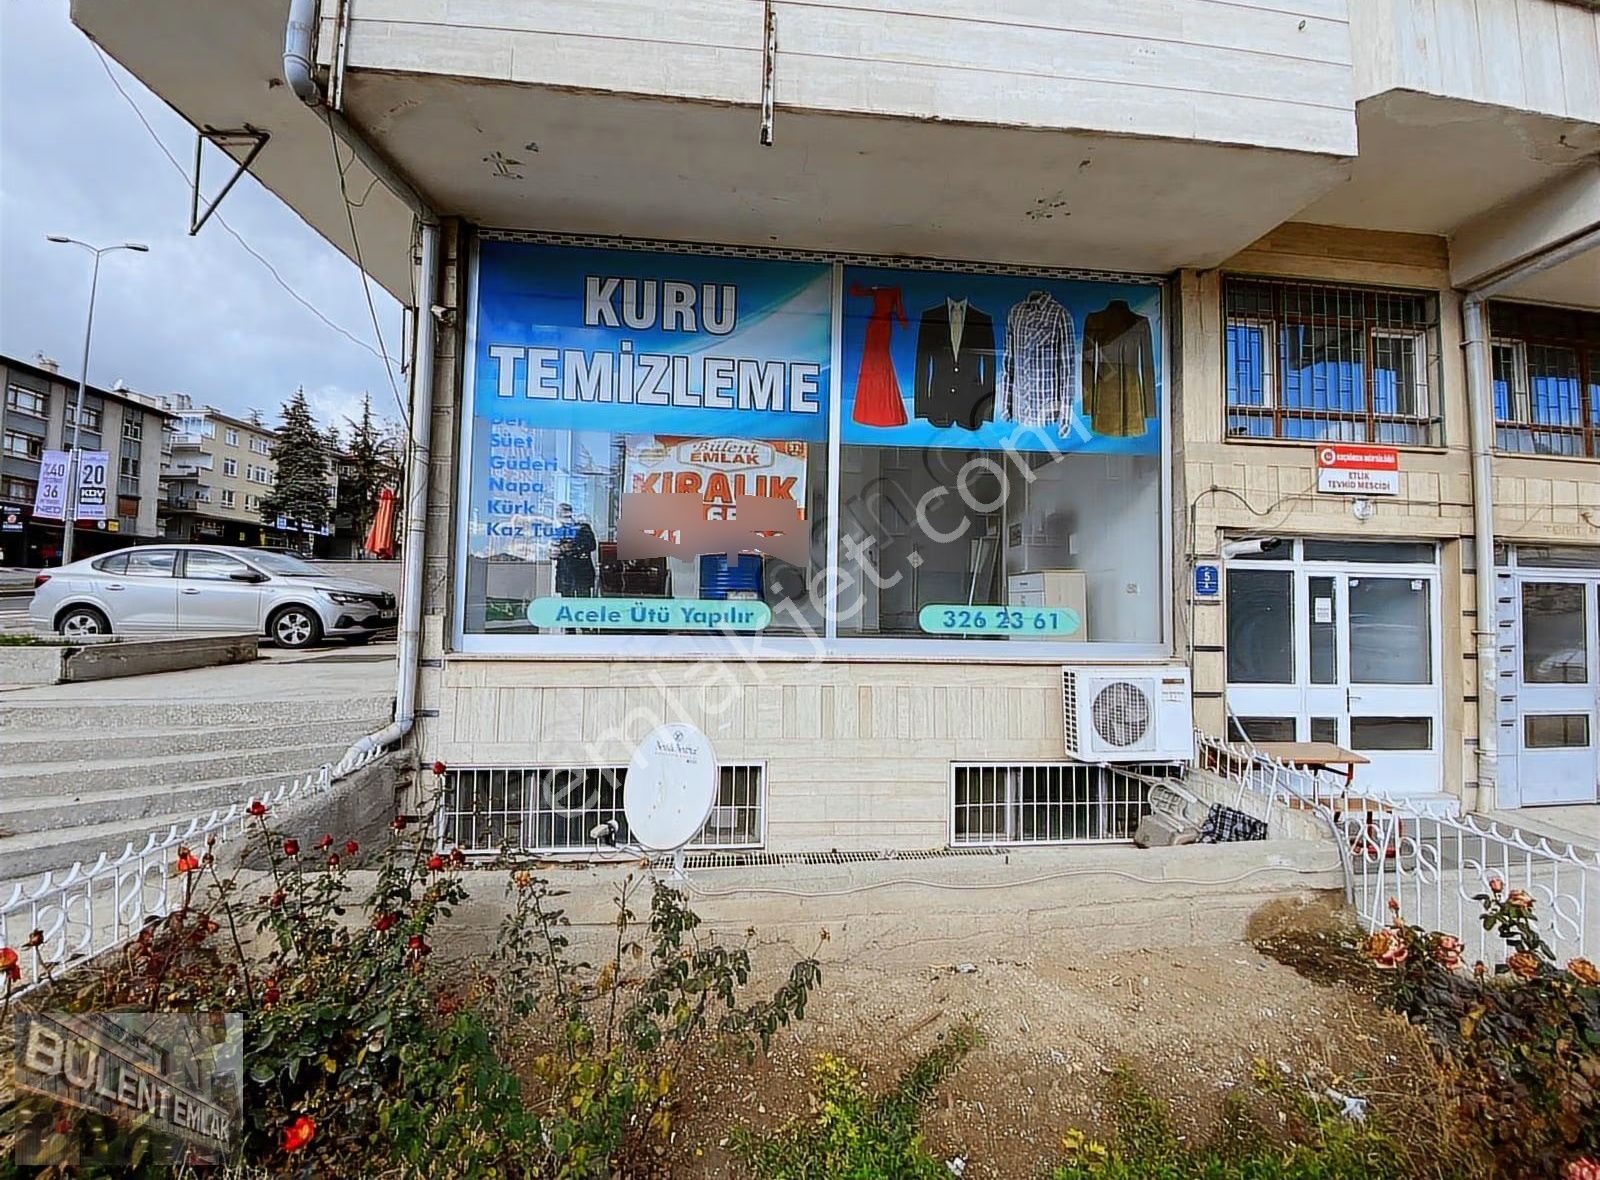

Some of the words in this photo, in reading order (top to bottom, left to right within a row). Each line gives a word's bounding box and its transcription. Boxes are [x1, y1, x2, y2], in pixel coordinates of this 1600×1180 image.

[584, 275, 738, 335] KURU
[489, 340, 822, 413] TEMİZLEME
[490, 455, 557, 471] Güderi
[690, 452, 760, 465] EMLAK
[44, 484, 58, 498] 36
[489, 477, 544, 495] Napa
[488, 500, 534, 514] Kürk
[487, 523, 524, 536] Kaz
[555, 605, 622, 623] Acele
[630, 602, 670, 623] Ütü
[681, 607, 755, 627] Yapılır
[943, 611, 986, 628] 326
[996, 612, 1023, 629] 23
[1033, 613, 1058, 629] 61
